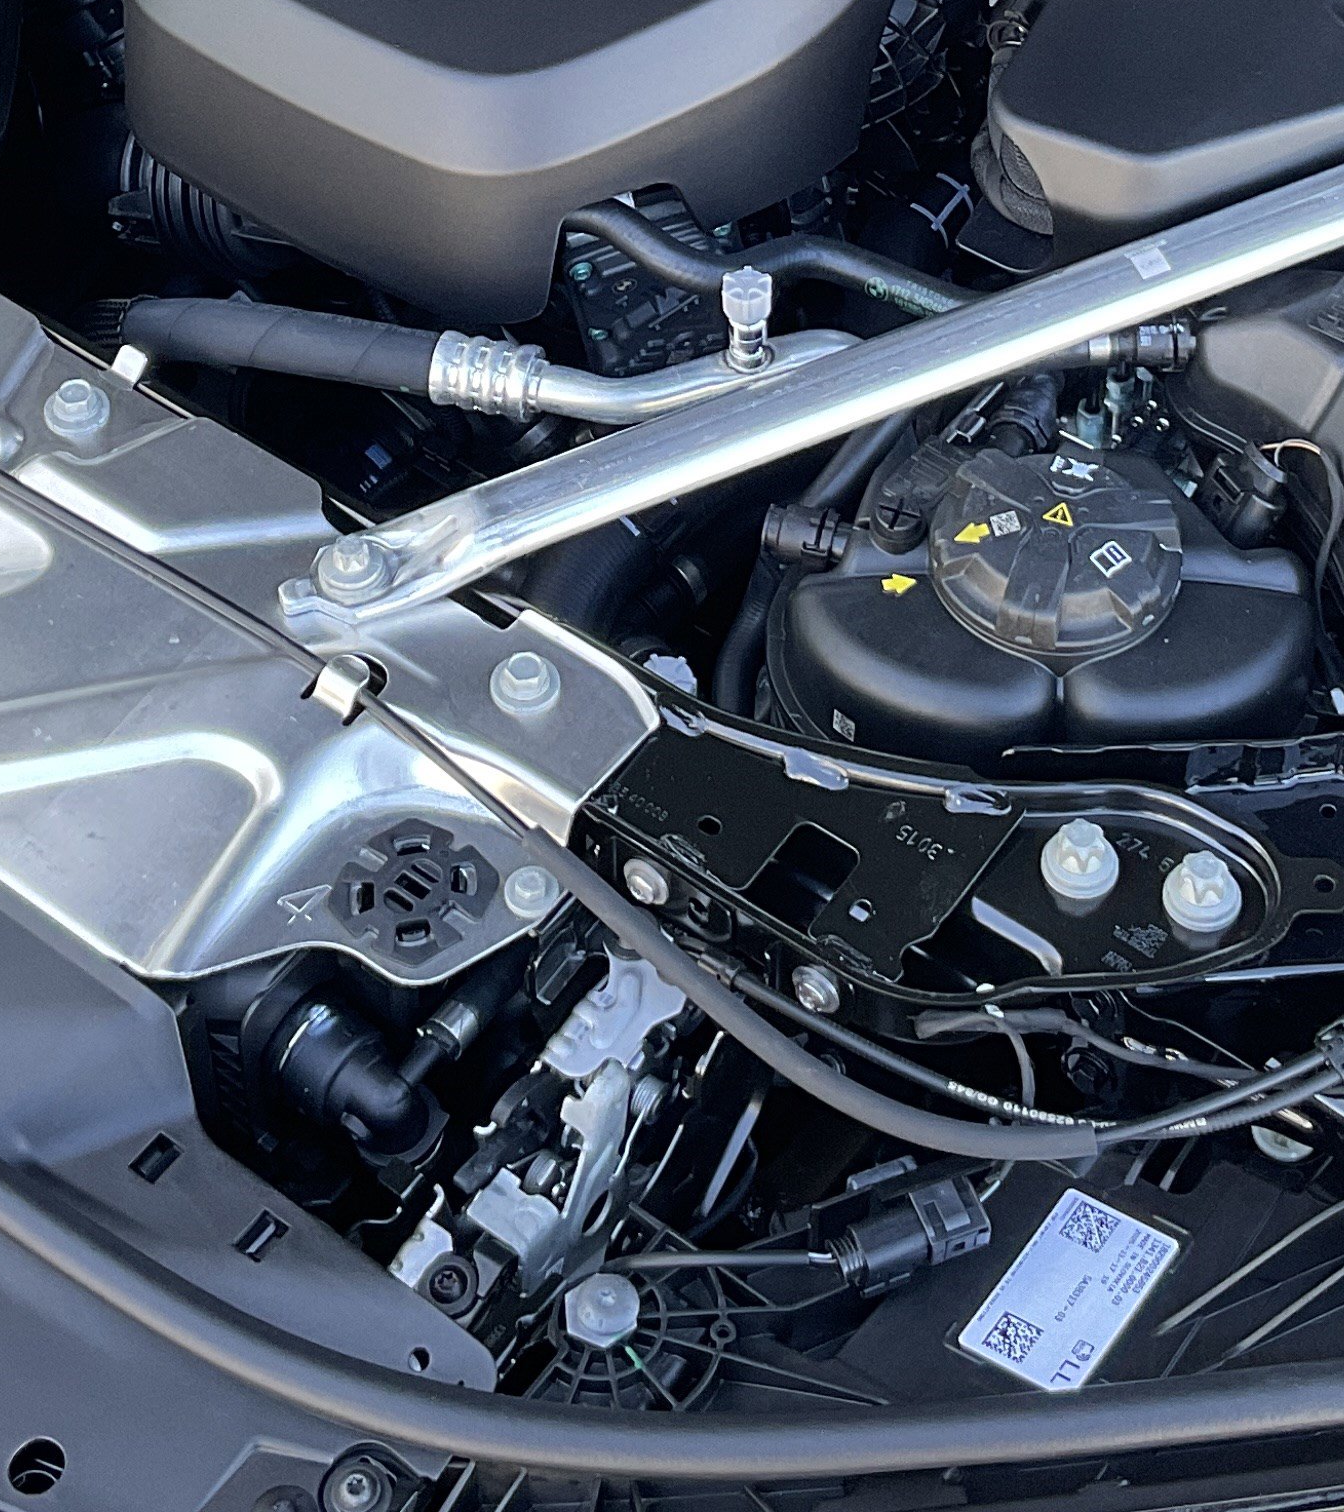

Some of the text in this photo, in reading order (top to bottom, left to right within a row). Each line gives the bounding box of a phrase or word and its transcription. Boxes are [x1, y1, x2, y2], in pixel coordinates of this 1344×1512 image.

[894, 822, 944, 861] 3015
[1135, 1231, 1151, 1249] MADE
[1049, 1358, 1081, 1390] LL
